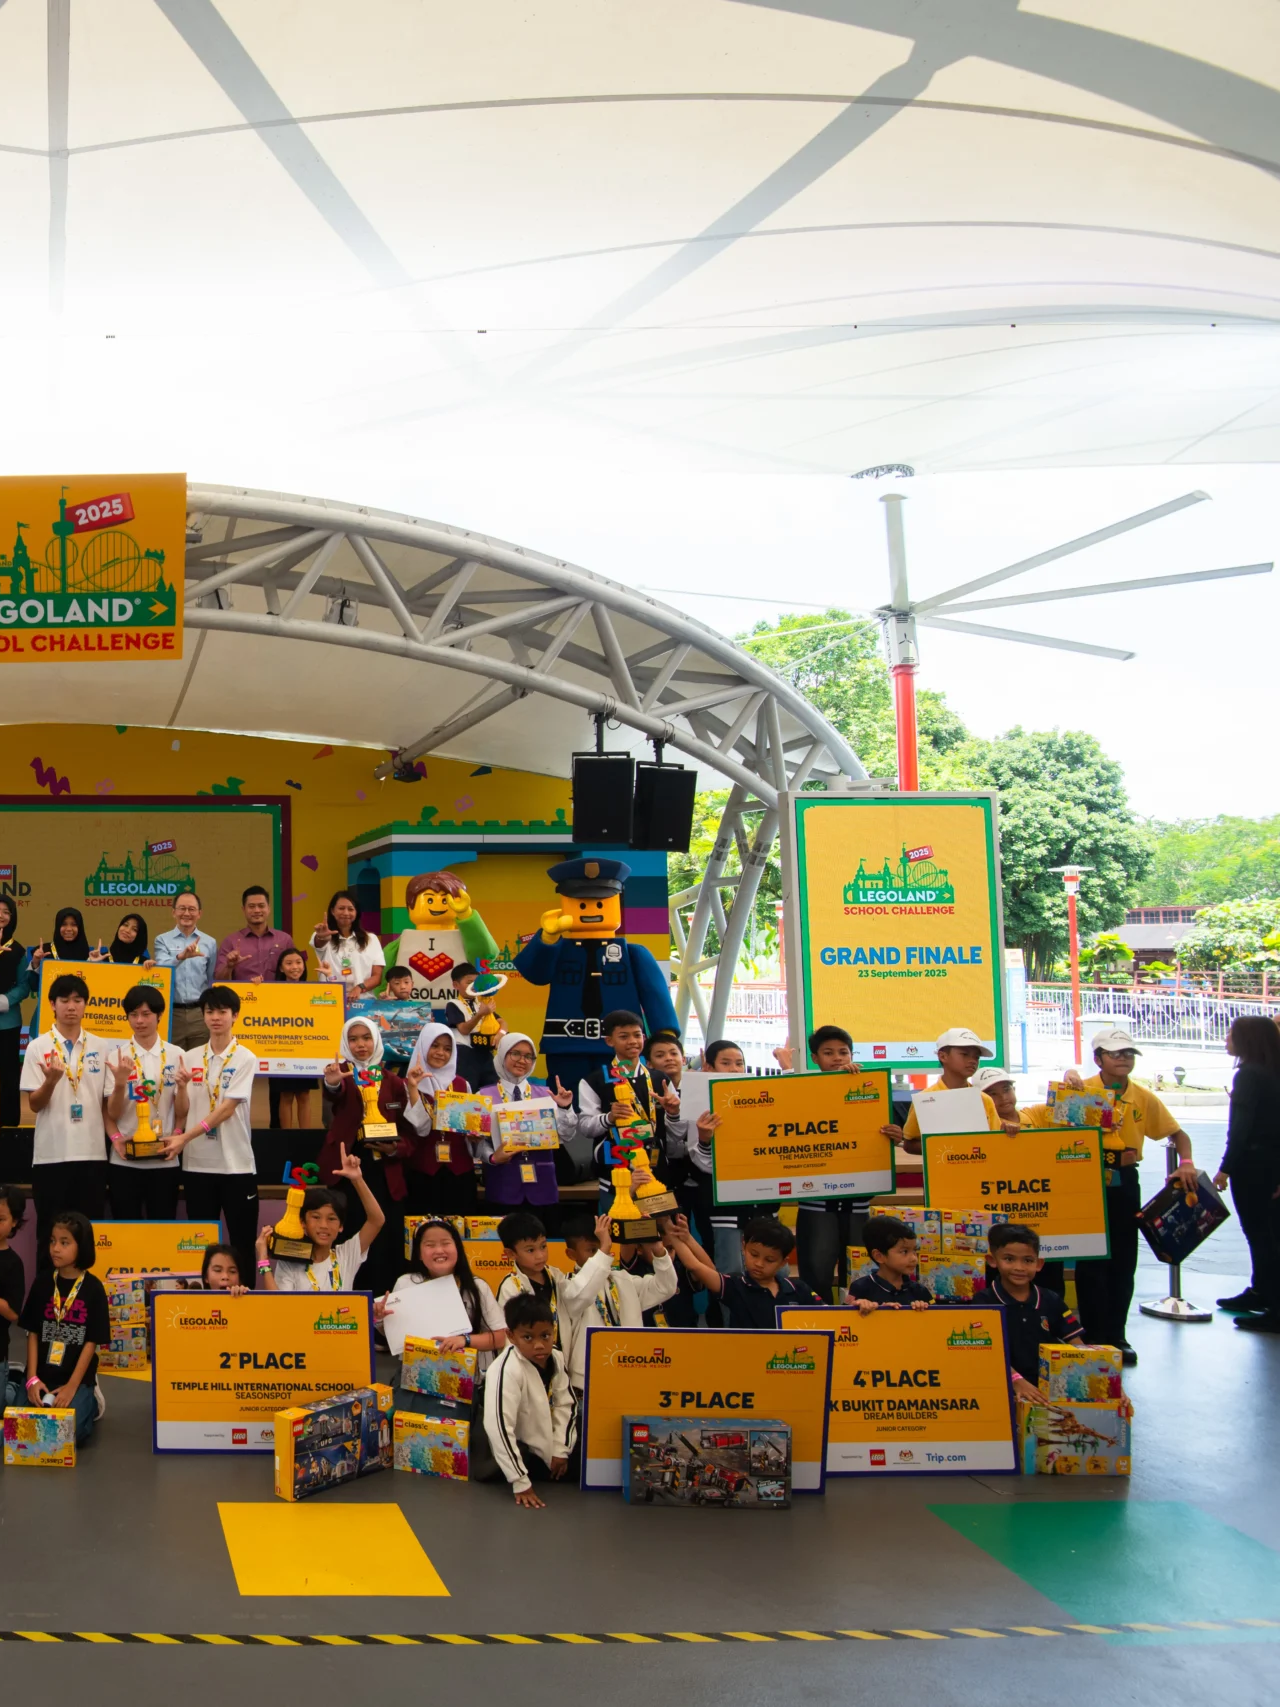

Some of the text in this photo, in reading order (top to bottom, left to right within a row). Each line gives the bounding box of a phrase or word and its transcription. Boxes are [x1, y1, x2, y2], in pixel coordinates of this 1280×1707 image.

[75, 498, 124, 526] 2025
[30, 632, 175, 652] CHALLENGE
[151, 841, 173, 853] 2025
[909, 848, 929, 859] 2025
[100, 883, 179, 894] LEGOLAND
[859, 891, 938, 902] LEGOLAND
[85, 898, 130, 907] SCHOOL
[844, 906, 955, 915] SCHOOL CHALLENGE
[429, 938, 435, 950] I
[820, 947, 982, 965] GRAND FINALE
[871, 969, 922, 979] September
[924, 969, 947, 977] 2025
[243, 1017, 314, 1027] CHAMPION
[353, 1064, 383, 1087] LSC
[602, 1060, 635, 1086] LSC
[128, 1080, 156, 1103] LSC
[734, 1097, 774, 1105] LEGOLAND
[784, 1120, 838, 1136] PLACE
[753, 1147, 766, 1155] SK
[769, 1144, 811, 1155] KUBANG
[813, 1142, 849, 1152] KERIAN
[794, 1151, 833, 1160] MAVERICKS
[947, 1153, 986, 1161] LEGOLAND
[282, 1160, 320, 1190] LSC
[823, 1182, 855, 1190] Trip.com
[997, 1179, 1051, 1194] PLACE
[1001, 1201, 1048, 1212] IBRAHIM
[240, 1353, 306, 1369] PLACE
[618, 1356, 671, 1364] LEGOLAND
[872, 1370, 940, 1387] PLACE
[171, 1382, 356, 1392] TEMPLE HILL INTERNATIONAL SCHOOL
[235, 1391, 292, 1400] SEASONSPOT
[681, 1392, 754, 1409] PLACE
[842, 1398, 979, 1412] BUKIT DAMANSARA
[864, 1412, 937, 1420] DREAM BUILDERS
[404, 1421, 428, 1431] classic
[633, 1429, 648, 1437] LEGO
[871, 1453, 885, 1461] LEGO
[926, 1453, 966, 1464] Trip.com
